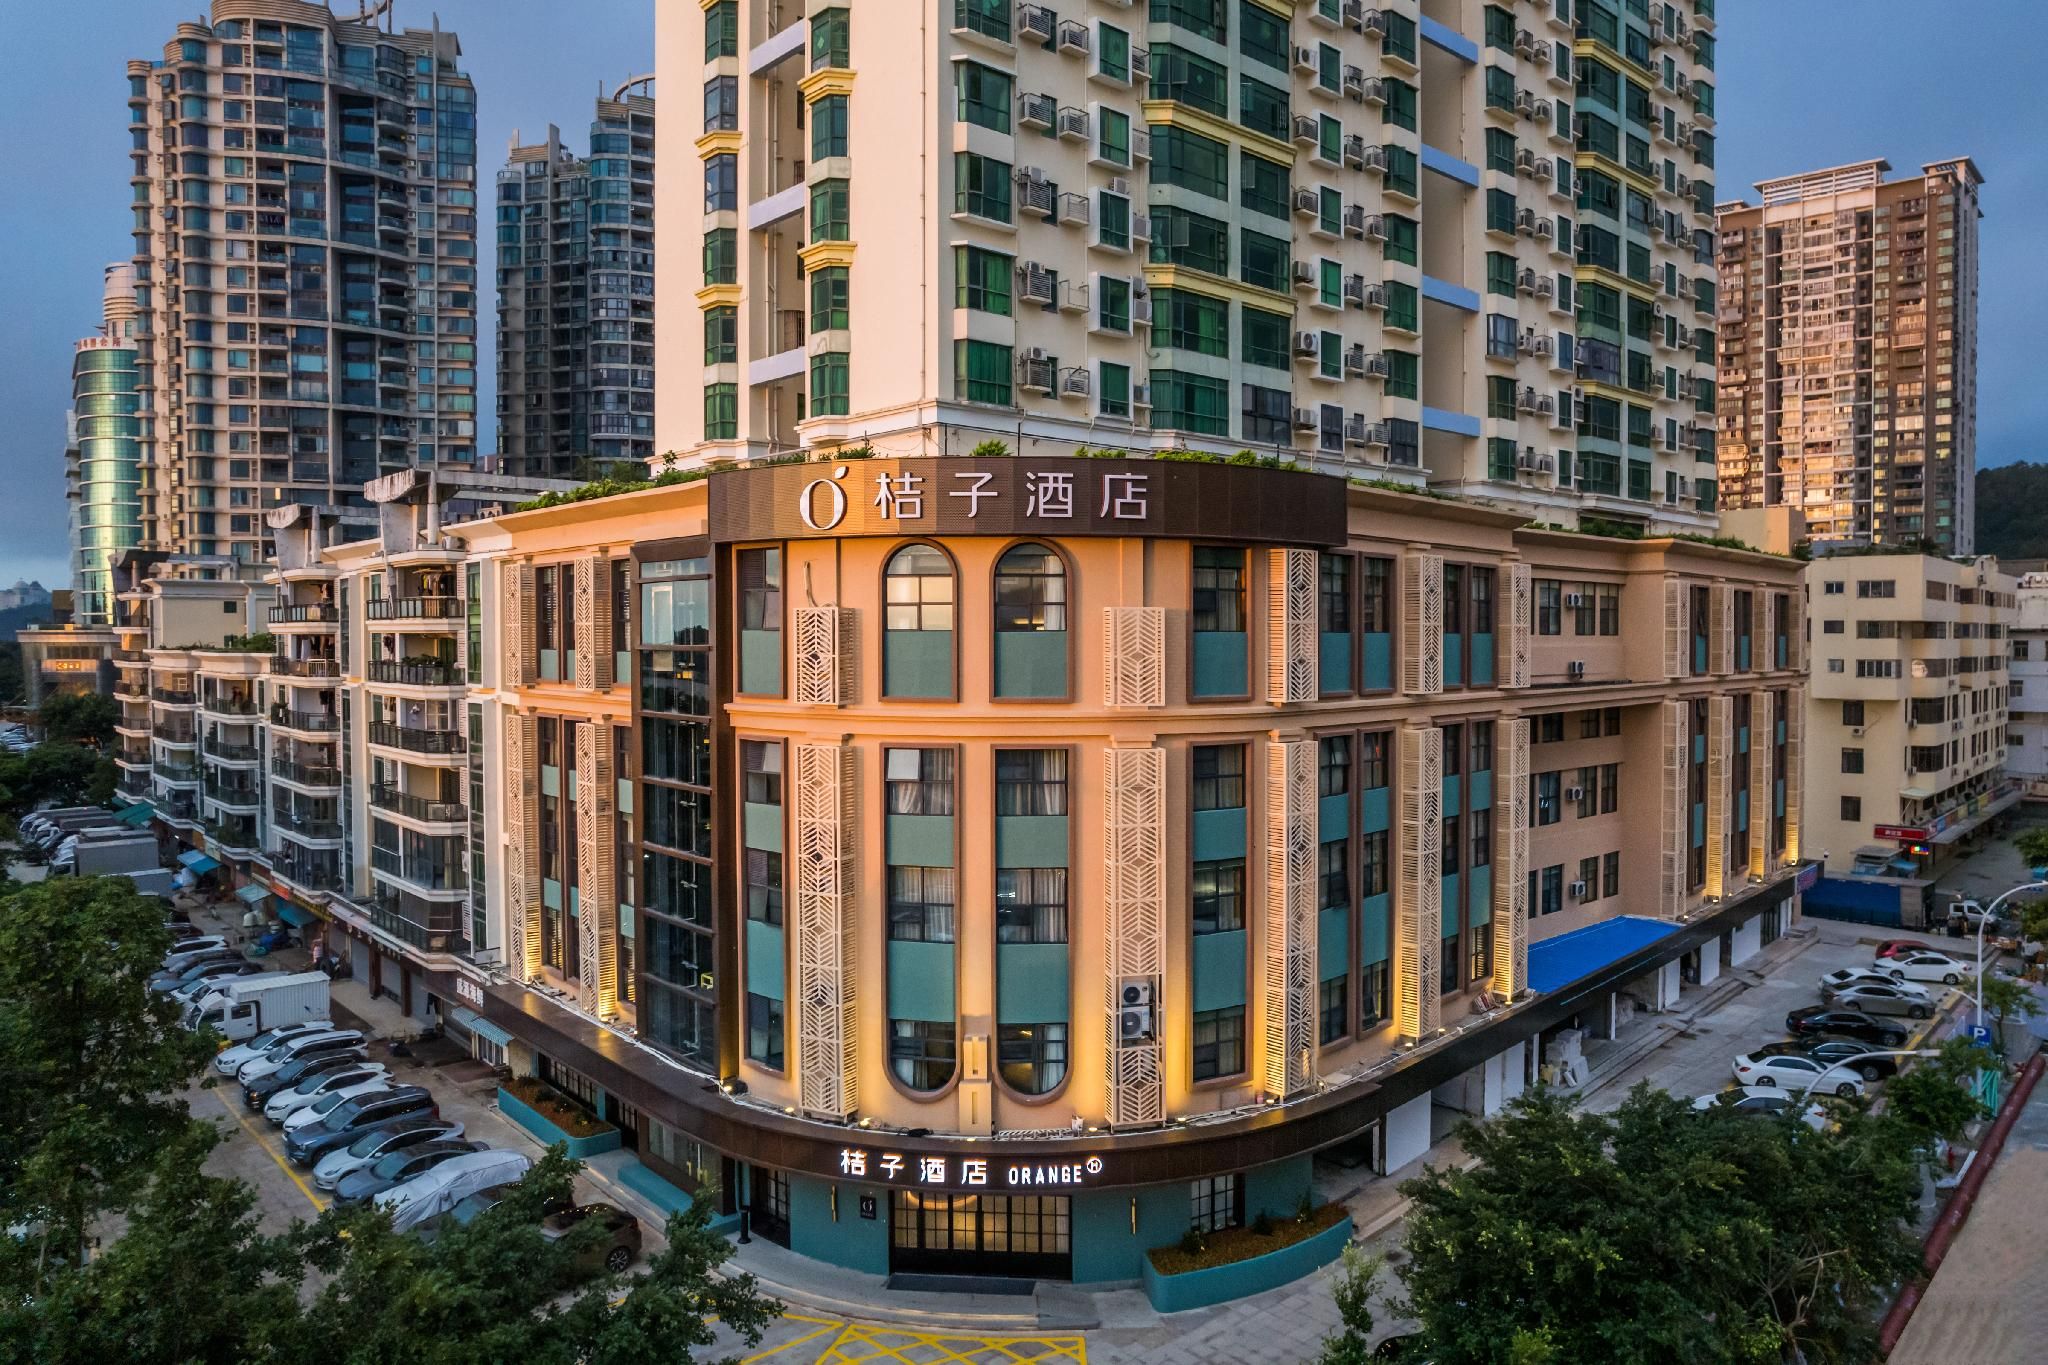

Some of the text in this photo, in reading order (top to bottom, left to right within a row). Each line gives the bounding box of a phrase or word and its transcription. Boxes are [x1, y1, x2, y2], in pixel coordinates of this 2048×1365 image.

[874, 472, 1148, 520] 桔子酒店
[840, 1149, 987, 1185] 桔子酒店
[1008, 1165, 1082, 1185] ORANGE
